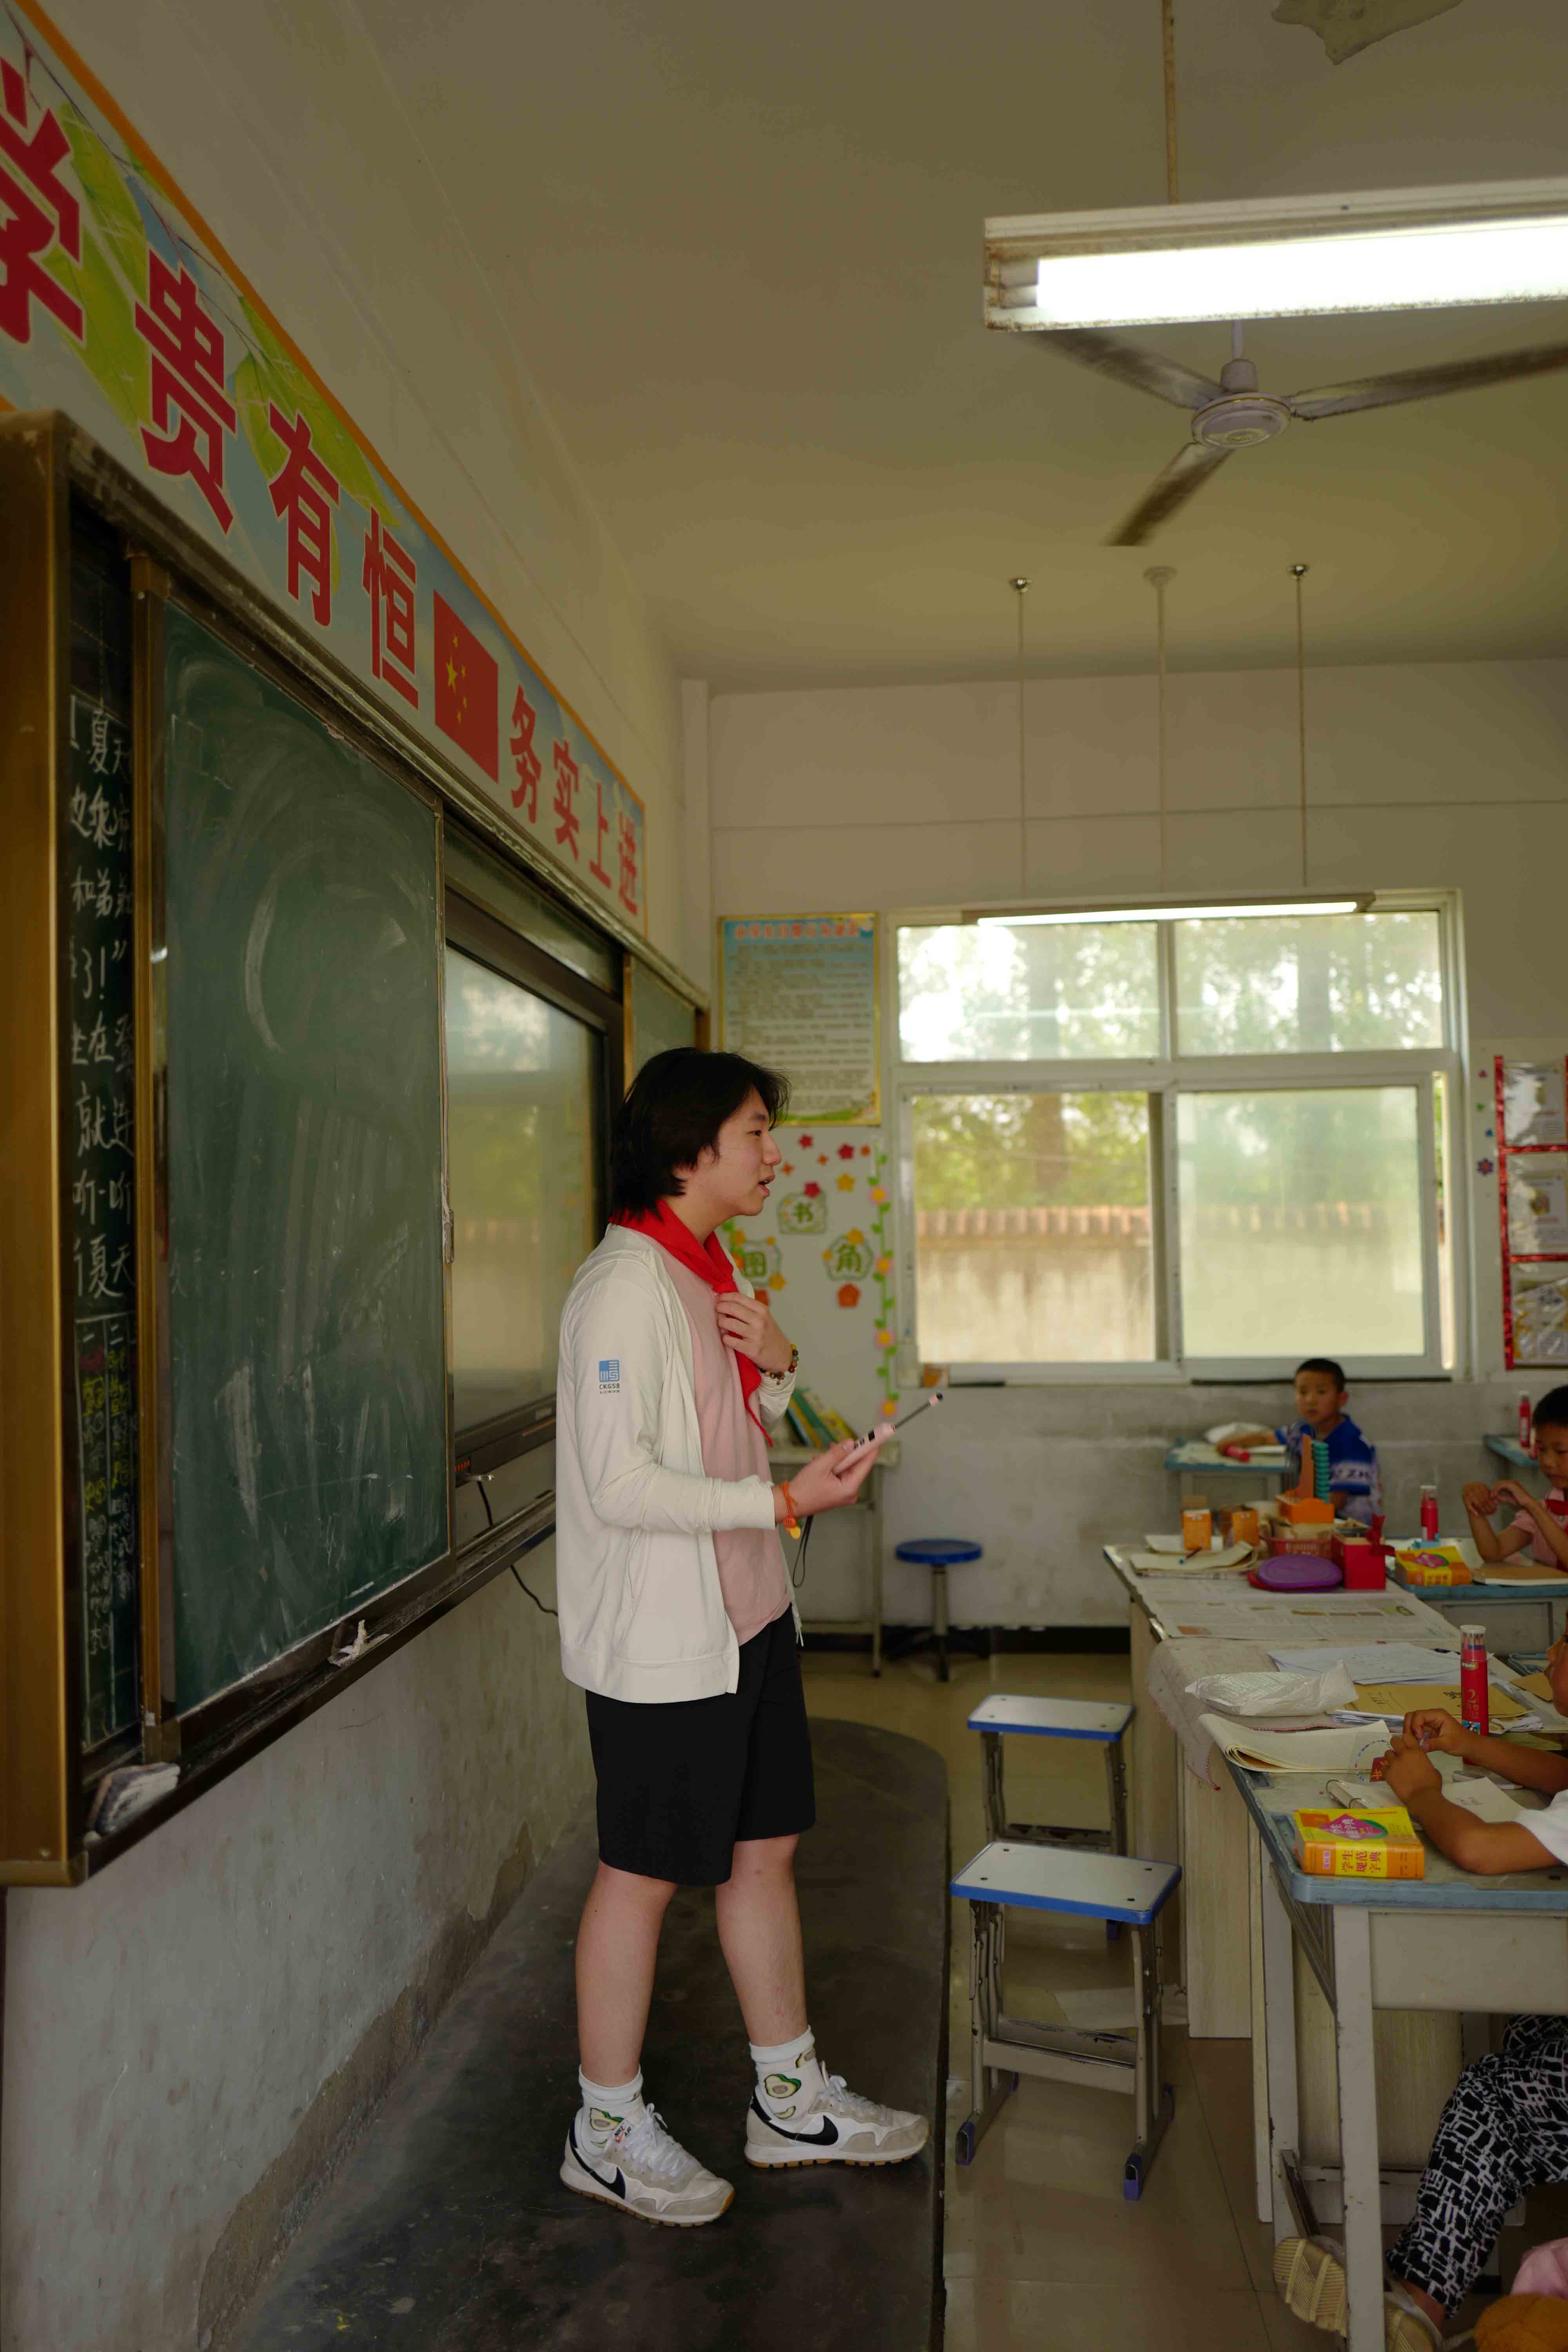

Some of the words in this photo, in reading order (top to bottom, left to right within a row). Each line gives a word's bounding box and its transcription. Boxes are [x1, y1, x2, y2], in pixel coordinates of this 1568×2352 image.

[510, 684, 638, 916] 务实上进
[793, 1202, 813, 1223] 书
[836, 1243, 860, 1272] 角
[1342, 1850, 1353, 1873] 学生
[1369, 1851, 1381, 1873] 字典
